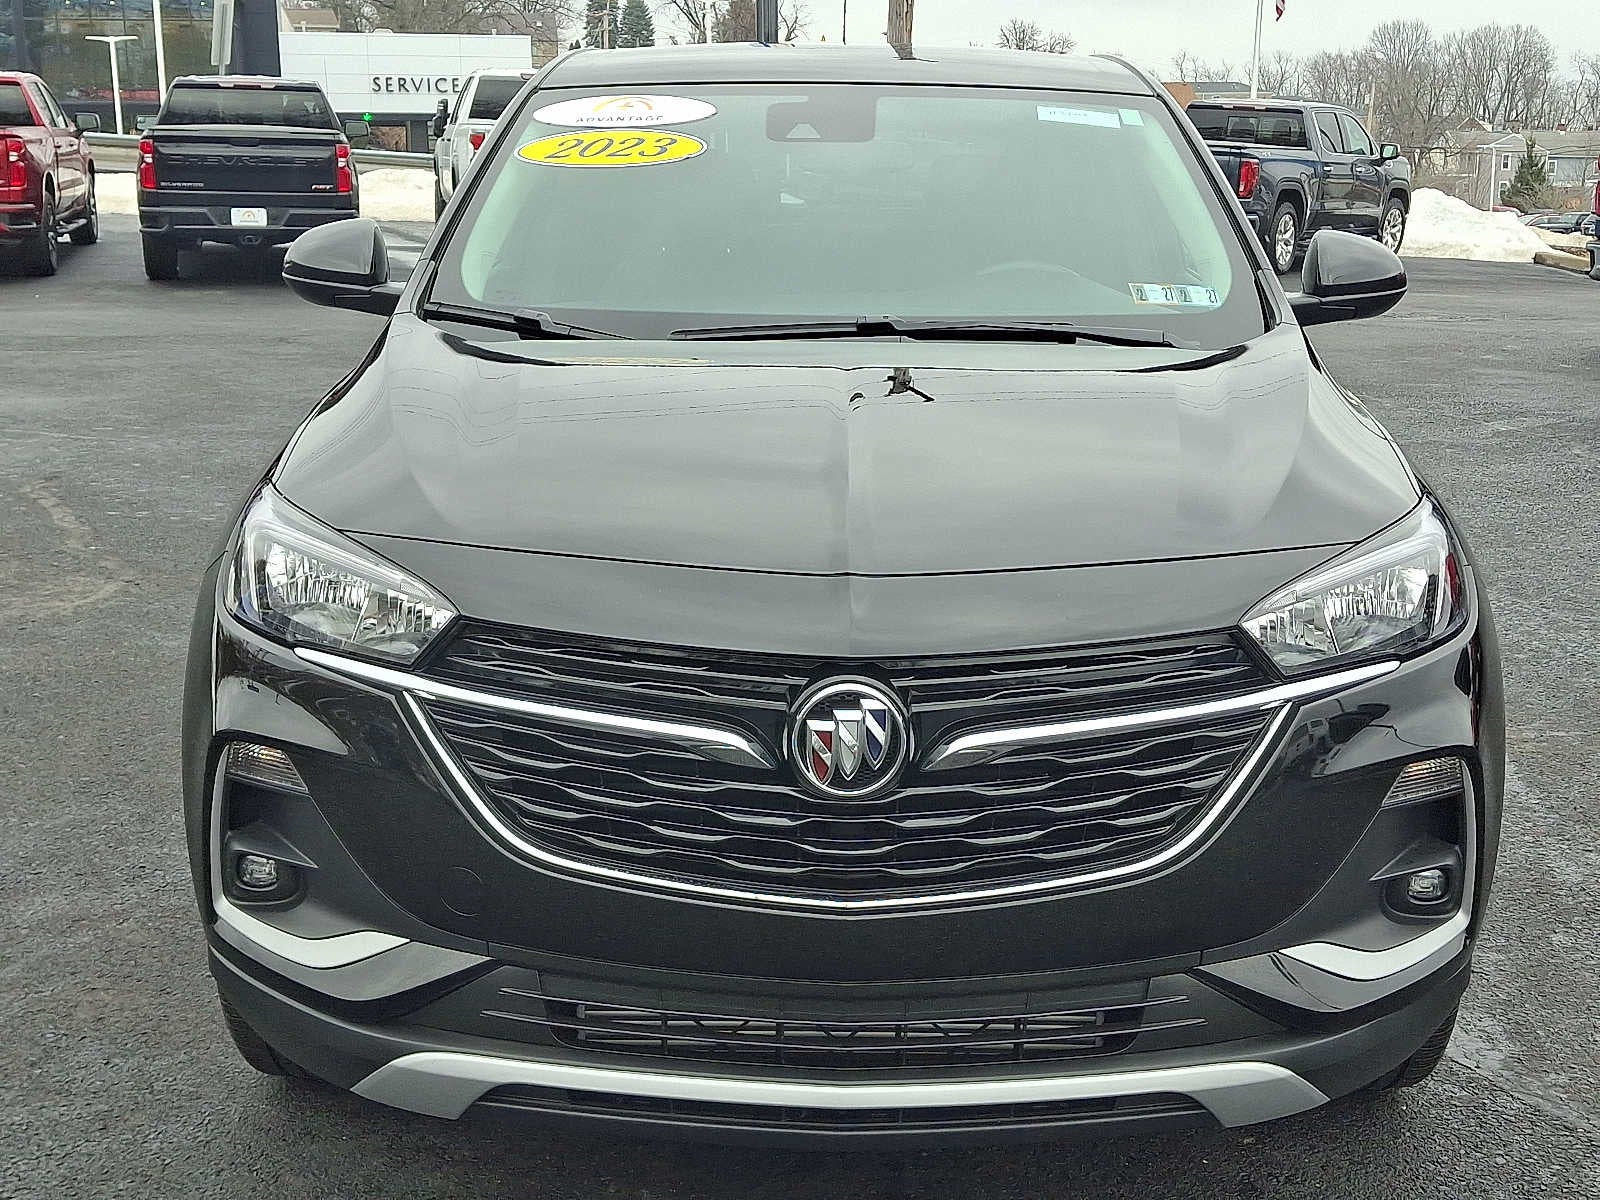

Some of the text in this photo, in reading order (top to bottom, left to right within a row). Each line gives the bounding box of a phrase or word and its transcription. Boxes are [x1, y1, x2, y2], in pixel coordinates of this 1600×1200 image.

[371, 76, 461, 94] SERVICE
[576, 115, 664, 123] ADVANTAGE
[544, 136, 678, 160] 2023
[167, 154, 325, 168] CHEVROLET
[1160, 286, 1174, 302] 27
[1205, 288, 1218, 304] 27
